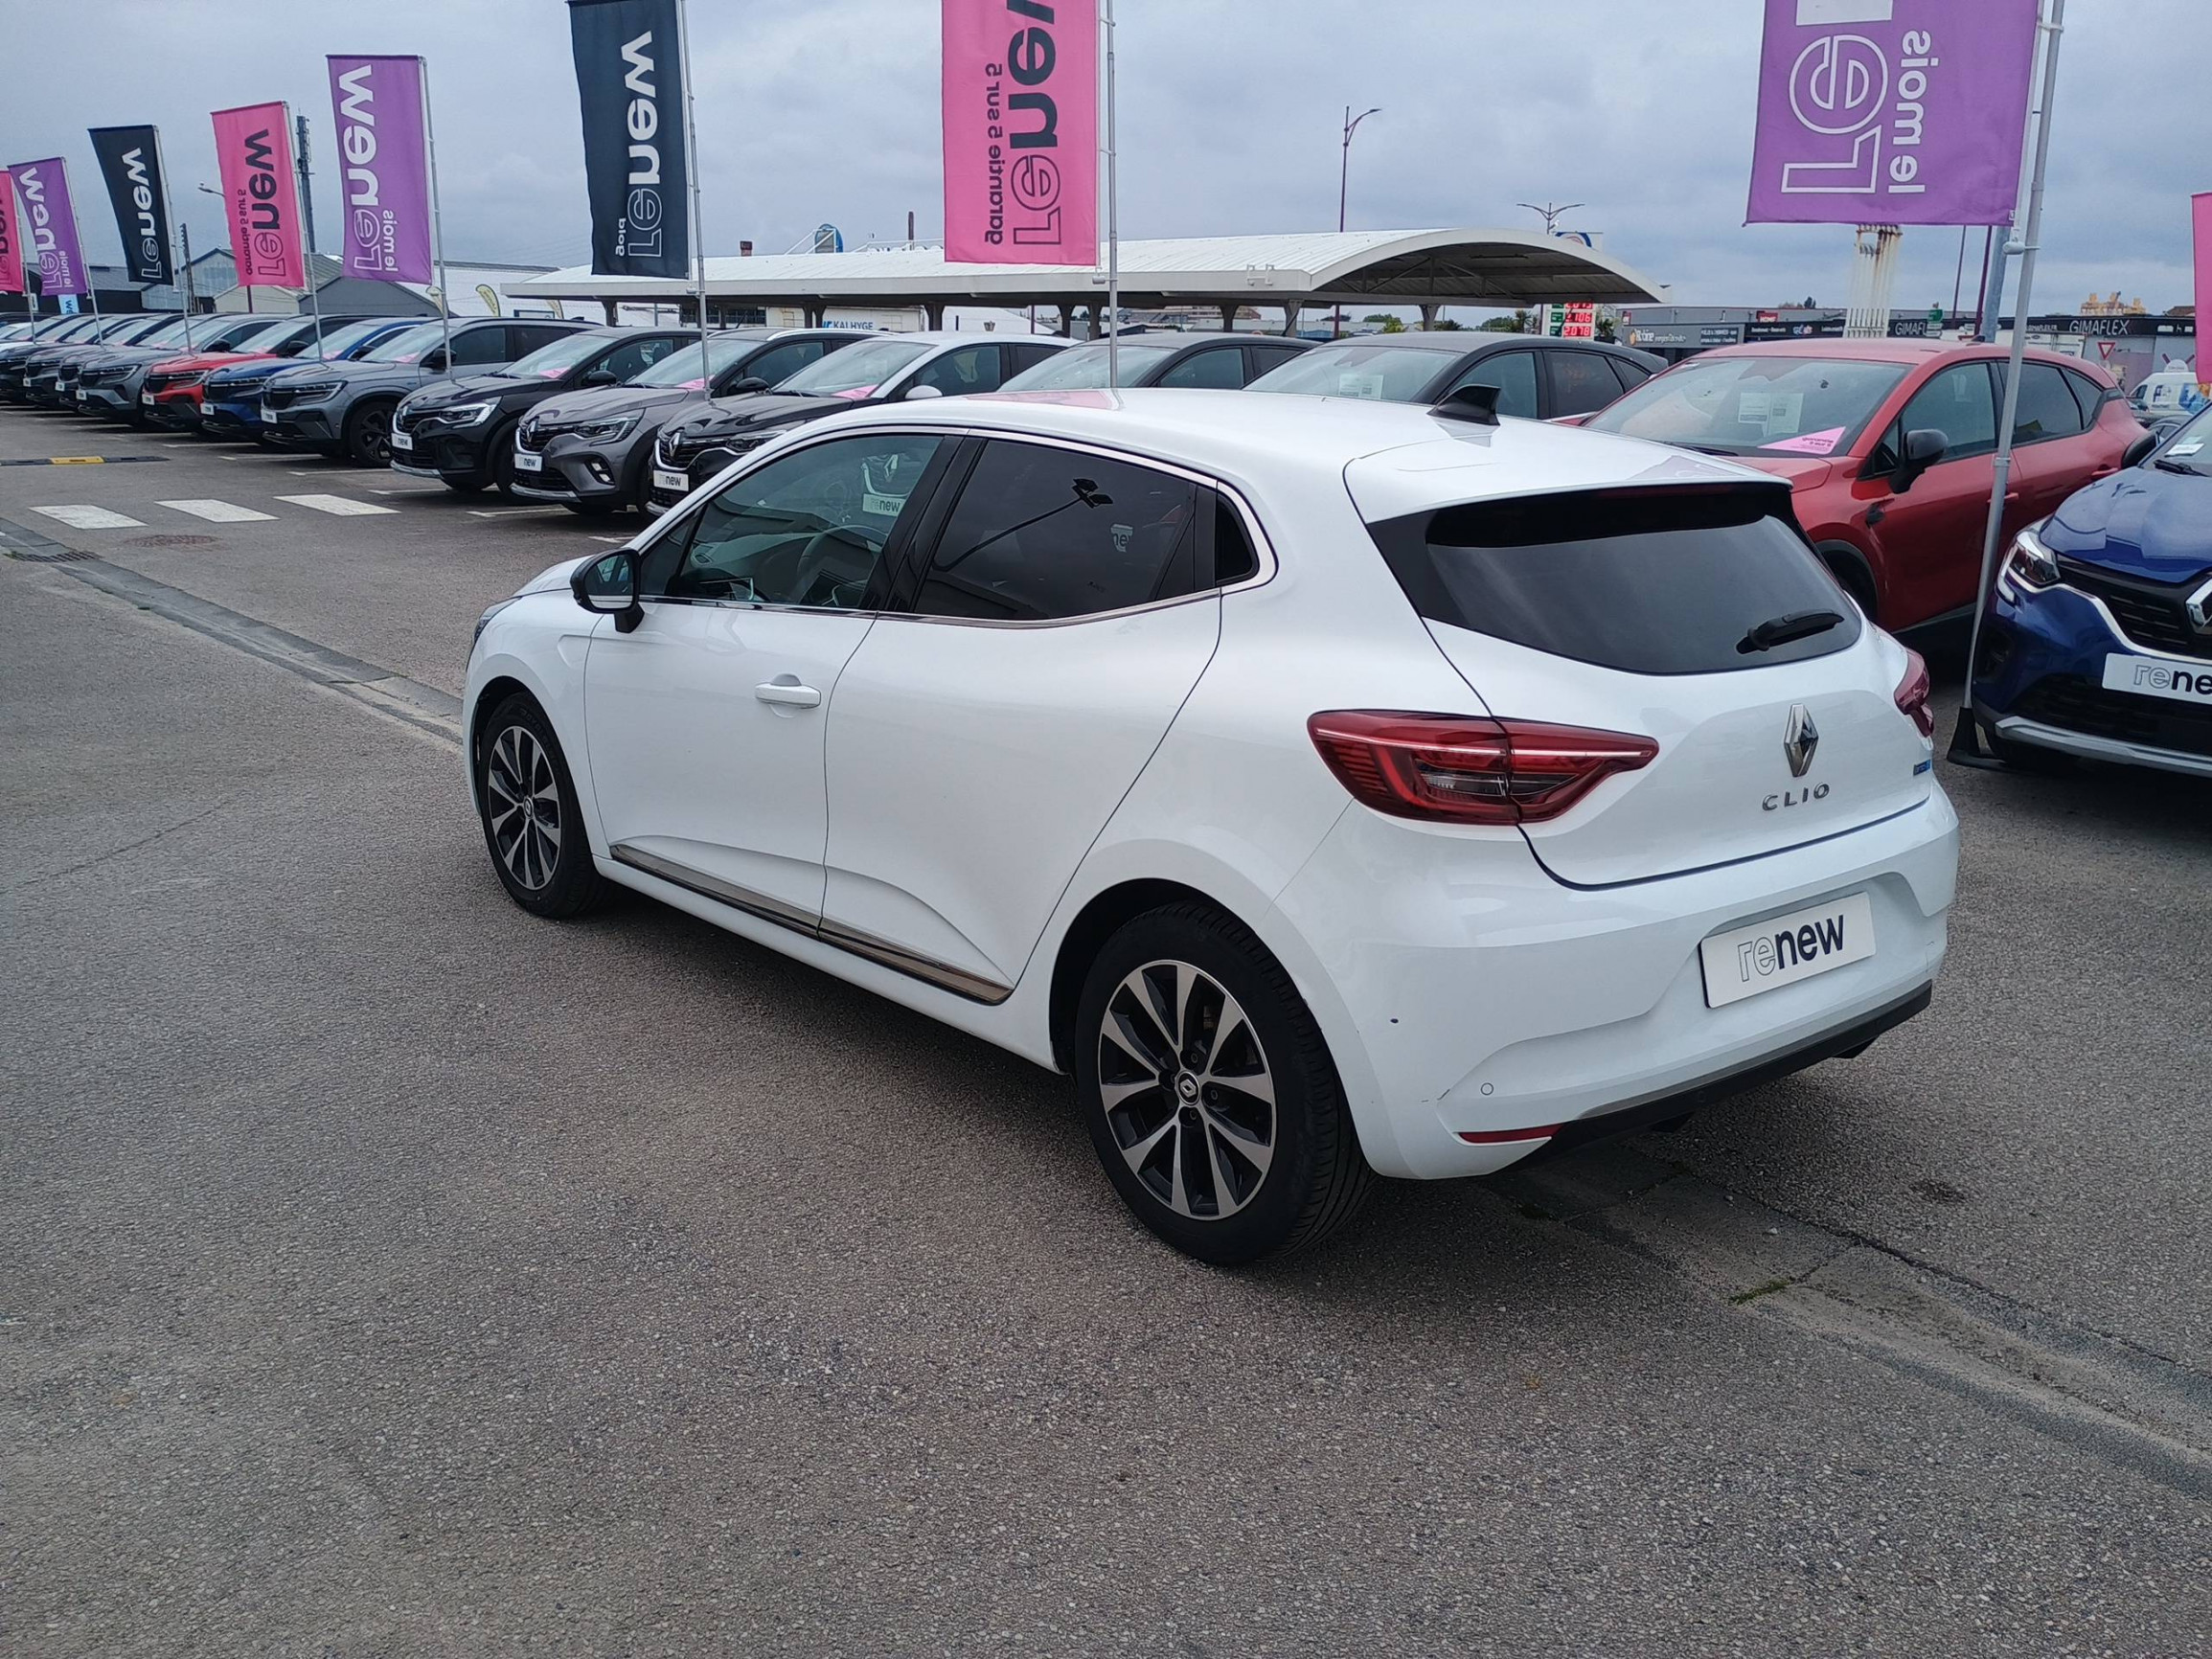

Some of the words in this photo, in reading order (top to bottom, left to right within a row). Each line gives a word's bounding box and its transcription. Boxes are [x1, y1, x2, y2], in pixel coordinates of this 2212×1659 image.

[2069, 320, 2130, 336] GIMAFLEX
[1762, 782, 1831, 811] CLIO
[1737, 915, 1845, 983] renew
